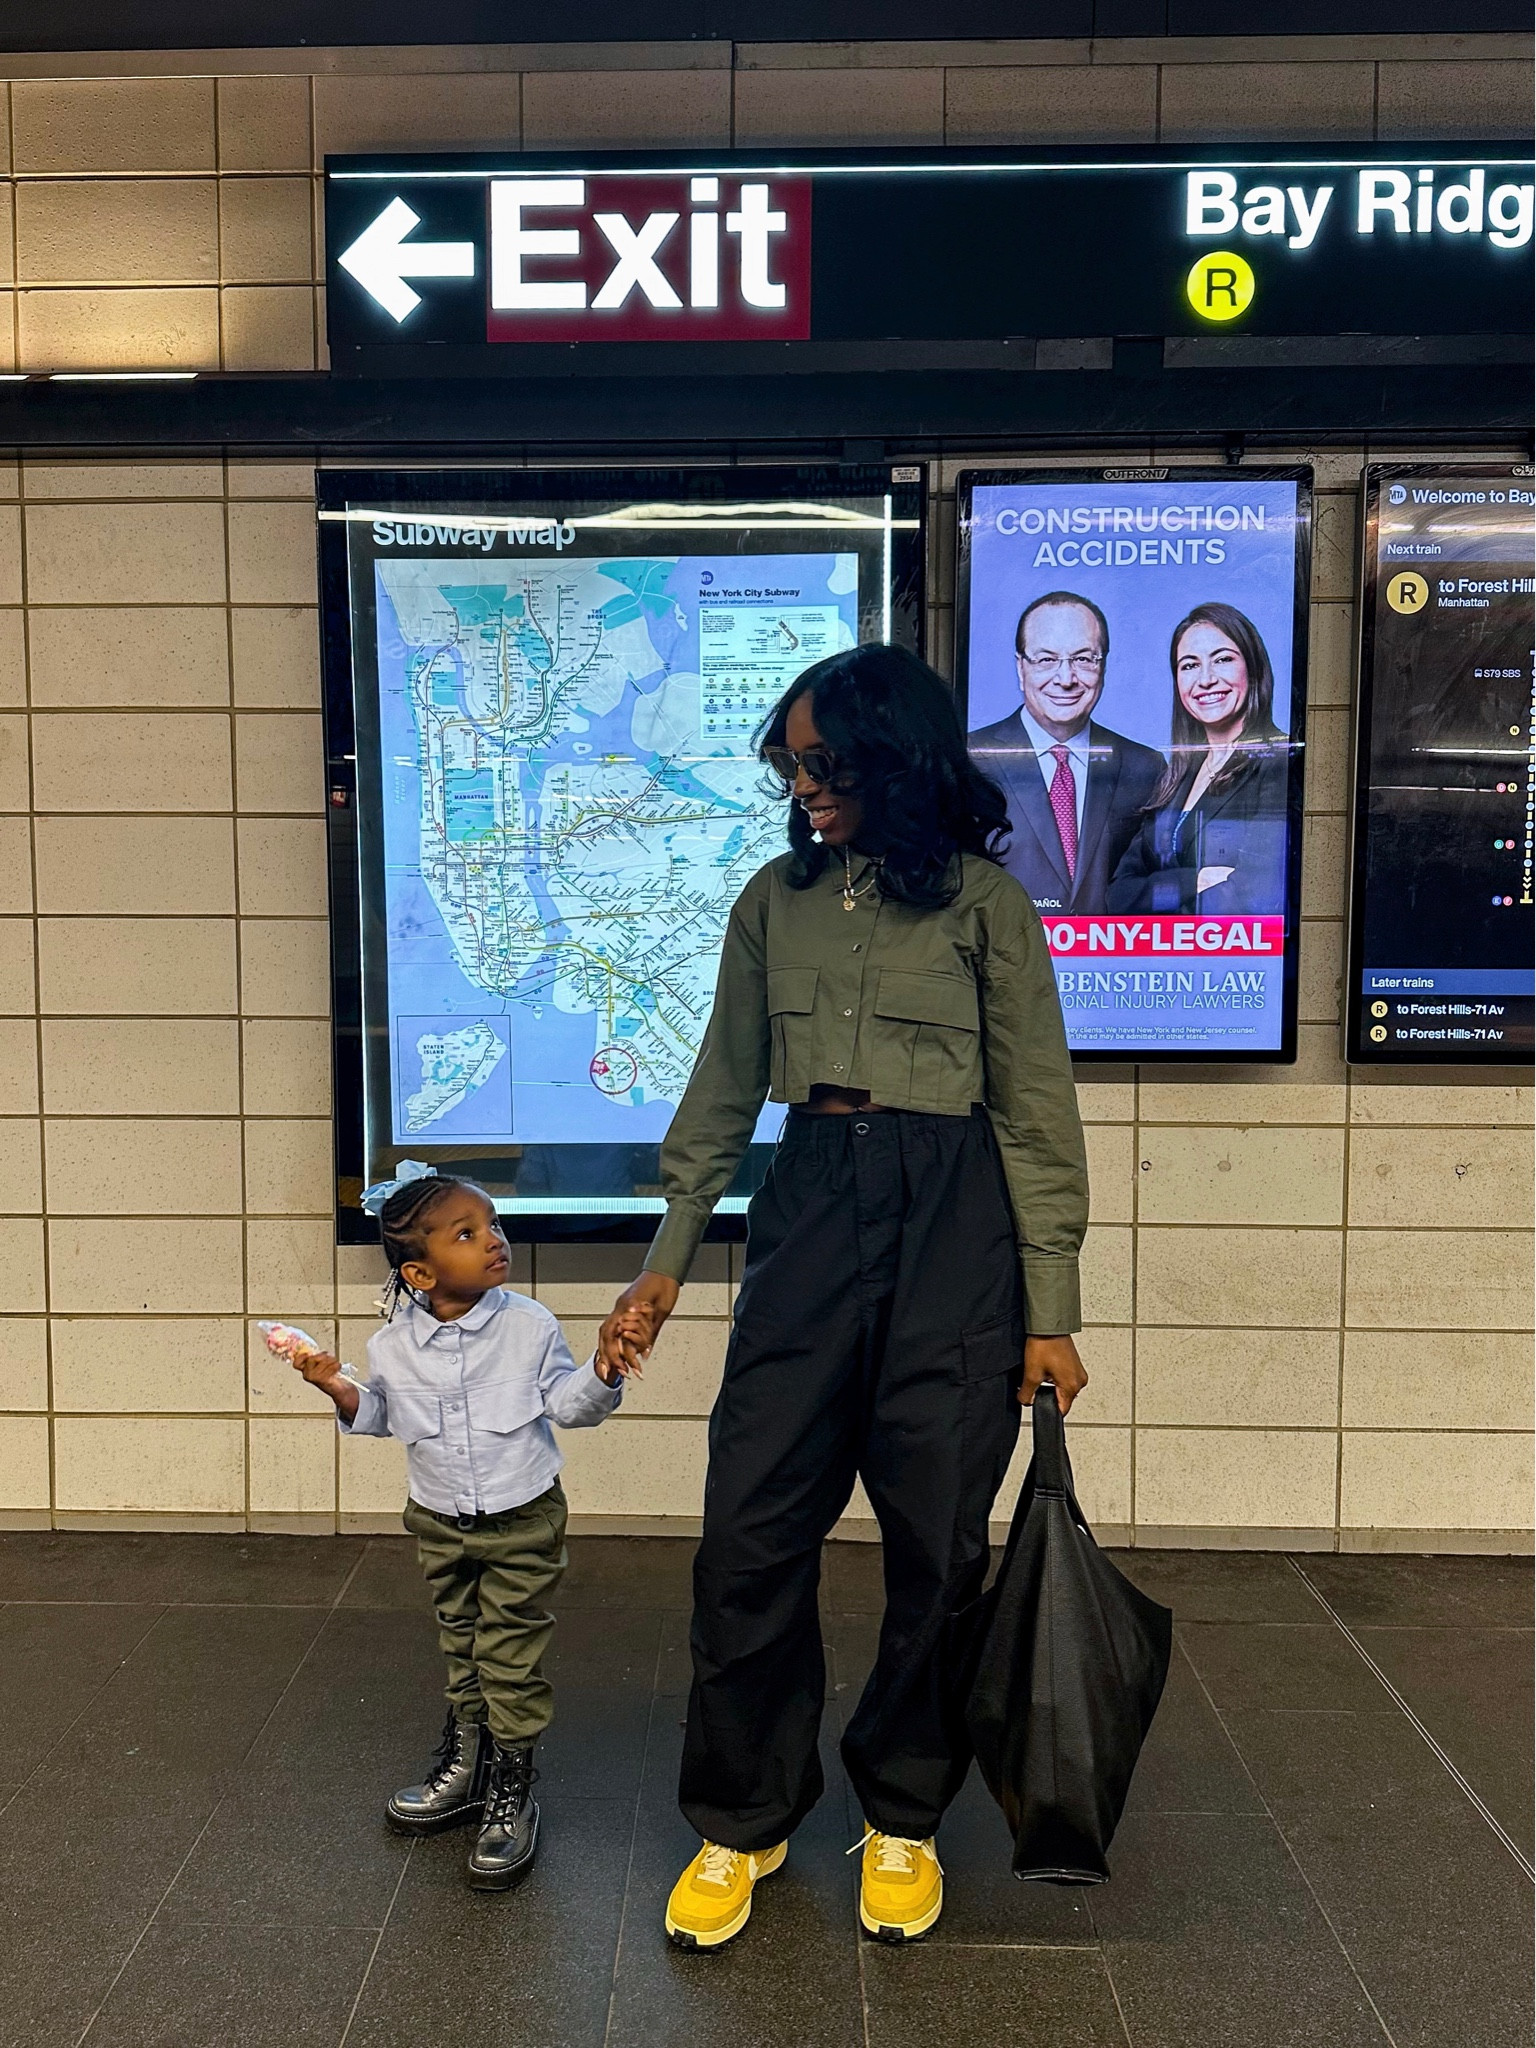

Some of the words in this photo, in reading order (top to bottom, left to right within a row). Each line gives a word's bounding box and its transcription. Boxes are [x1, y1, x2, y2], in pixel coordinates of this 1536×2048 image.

[1186, 170, 1334, 249] Bay
[1358, 169, 1535, 248] Ridg
[490, 176, 787, 310] Exit
[1204, 267, 1238, 307] R
[1412, 489, 1485, 504] Welcome
[1489, 490, 1505, 503] to
[1509, 489, 1535, 506] Bay
[995, 504, 1265, 536] CONSTRUCTION
[372, 519, 497, 551] Subway
[506, 523, 576, 551] Map
[1032, 538, 1227, 568] ACCIDENTS
[1387, 544, 1413, 554] Next
[1416, 544, 1441, 554] train
[699, 589, 720, 597] New
[722, 589, 742, 597] York
[744, 588, 763, 598] City
[764, 588, 800, 598] Subway
[1400, 581, 1417, 604] R
[1438, 579, 1455, 593] to
[1458, 579, 1509, 593] Forest
[1512, 579, 1535, 592] Hill
[1438, 597, 1489, 607] Manhattan
[1483, 669, 1501, 678] S79
[1502, 669, 1521, 678] SBS
[1058, 971, 1194, 993] BENSTEIN
[1371, 976, 1401, 988] Later
[1403, 976, 1434, 988] trains
[1060, 994, 1109, 1009] ONAL
[1115, 994, 1176, 1009] INJURY
[1183, 994, 1265, 1009] LAWYERS
[1396, 1004, 1408, 1015] to
[1410, 1004, 1446, 1015] Forest
[1448, 1004, 1487, 1015] Hills-71
[1489, 1004, 1504, 1015] Av
[1080, 1026, 1103, 1034] clients.
[1203, 1026, 1226, 1035] Jersey
[1228, 1026, 1257, 1034] counsel.
[1100, 1033, 1113, 1041] may
[1396, 1028, 1408, 1039] to
[1409, 1028, 1446, 1039] Forest
[1447, 1028, 1485, 1039] Hills-71
[1487, 1029, 1503, 1039] Av
